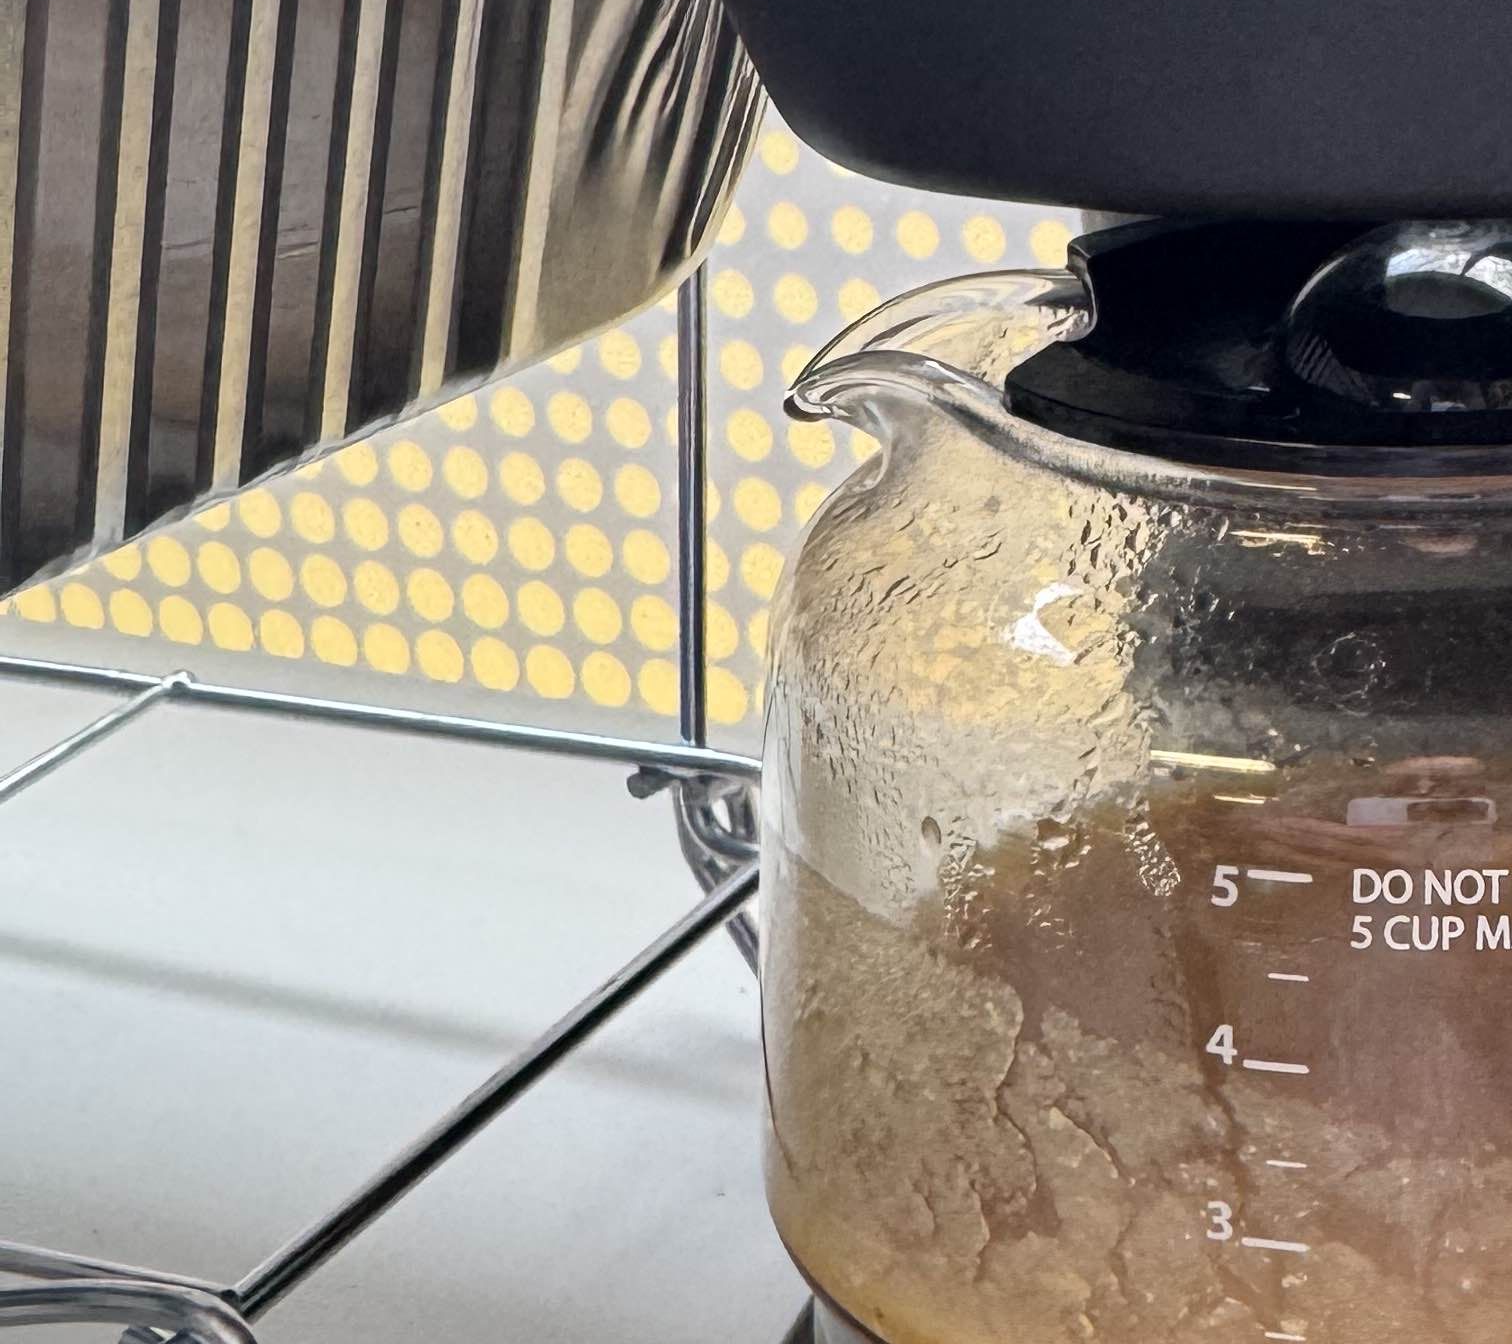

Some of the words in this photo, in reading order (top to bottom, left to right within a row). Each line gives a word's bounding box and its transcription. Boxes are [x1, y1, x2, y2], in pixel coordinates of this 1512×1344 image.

[1210, 864, 1240, 907] 5
[1351, 868, 1414, 905] DO
[1424, 868, 1510, 906] NOT
[1350, 915, 1373, 951] 5
[1383, 914, 1465, 951] CUP
[1205, 1023, 1238, 1065] 4
[1206, 1200, 1233, 1241] 3
